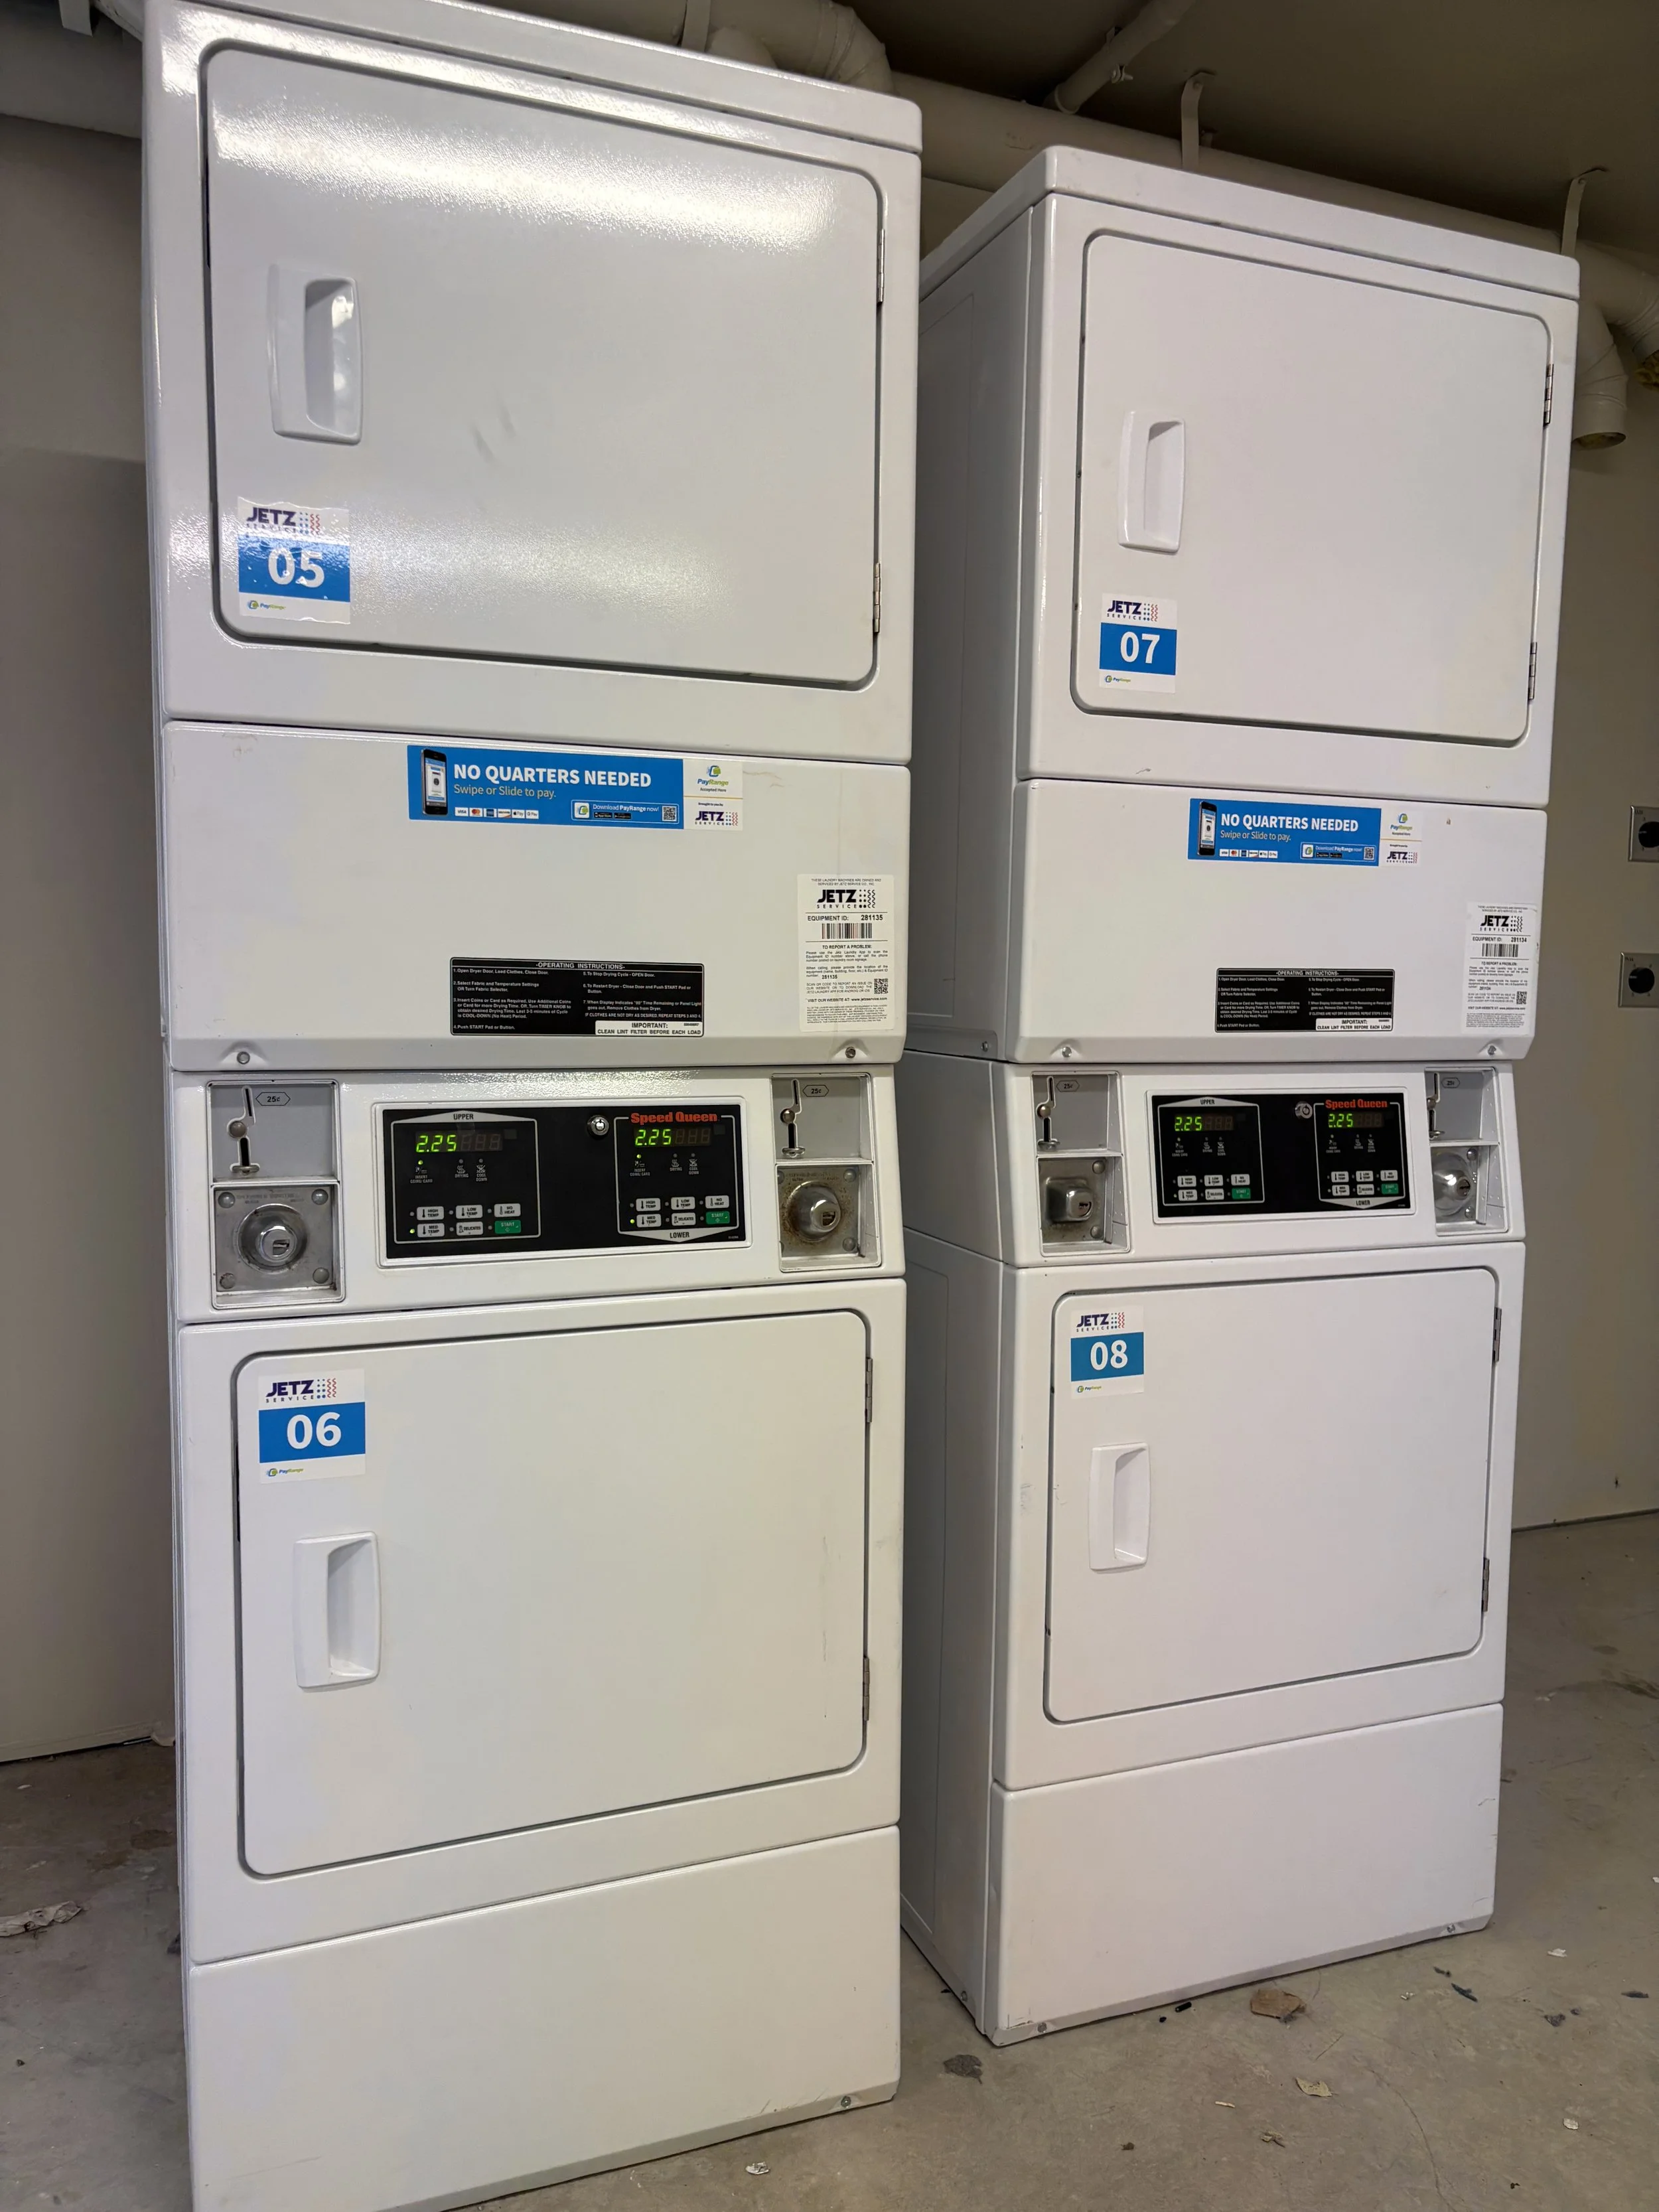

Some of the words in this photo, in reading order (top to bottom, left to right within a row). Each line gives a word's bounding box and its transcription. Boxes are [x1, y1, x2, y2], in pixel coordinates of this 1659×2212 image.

[246, 506, 297, 526] JETZ
[268, 548, 325, 588] 05
[1107, 600, 1142, 615] JETZ
[1120, 631, 1160, 664] 07
[454, 764, 481, 780] NO
[485, 765, 580, 784] QUARTERS
[585, 770, 652, 787] NEEDED
[454, 784, 484, 796] Swipe
[499, 786, 523, 796] Slide
[525, 788, 535, 796] to
[537, 790, 557, 800] pay.
[695, 811, 724, 821] JETZ
[1221, 813, 1240, 826] NO
[1243, 814, 1309, 830] QUARTERS
[1311, 818, 1359, 832] NEEDED
[1220, 830, 1241, 840] Swipe
[1251, 831, 1267, 840] Slide
[1387, 851, 1408, 860] JETZ
[817, 889, 857, 903] JETZ
[1480, 915, 1510, 927] JETZ
[1325, 1099, 1356, 1110] Speed
[1357, 1098, 1388, 1108] Queen
[631, 1112, 673, 1125] Speed
[675, 1111, 717, 1122] Queen
[1175, 1116, 1202, 1132] 2.25
[1328, 1113, 1353, 1128] 2.25
[415, 1134, 457, 1153] 2.25
[635, 1129, 672, 1145] 2.25
[1076, 1313, 1110, 1327] JETZ
[1090, 1339, 1128, 1370] 08
[265, 1379, 315, 1397] JETZ
[287, 1412, 342, 1449] 06
